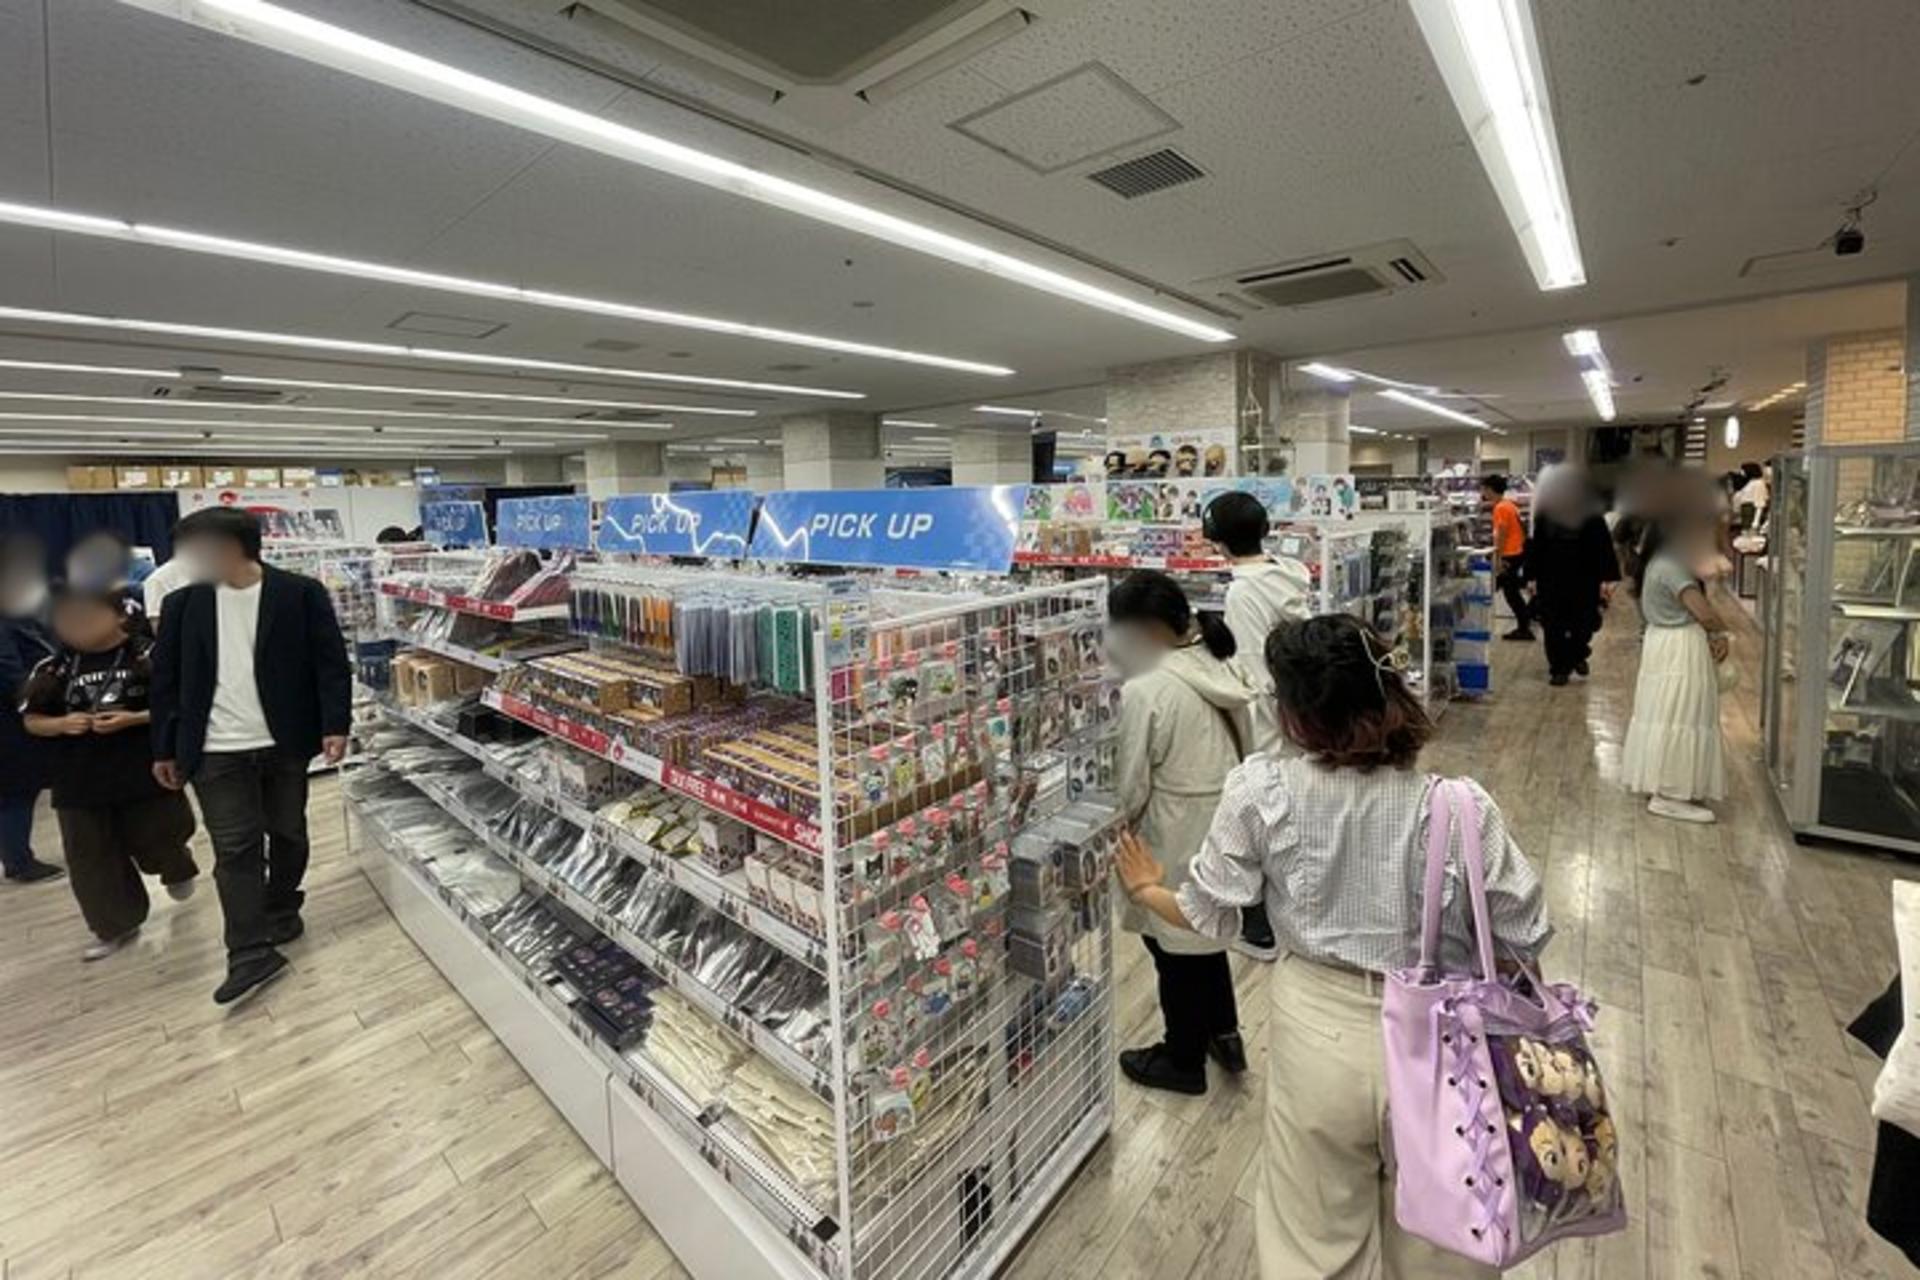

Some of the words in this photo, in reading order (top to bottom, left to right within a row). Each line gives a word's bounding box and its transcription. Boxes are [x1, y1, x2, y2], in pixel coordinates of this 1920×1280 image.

[631, 513, 670, 534] PICK
[675, 513, 702, 534] UP
[810, 513, 878, 538] PICK
[886, 513, 934, 539] UP
